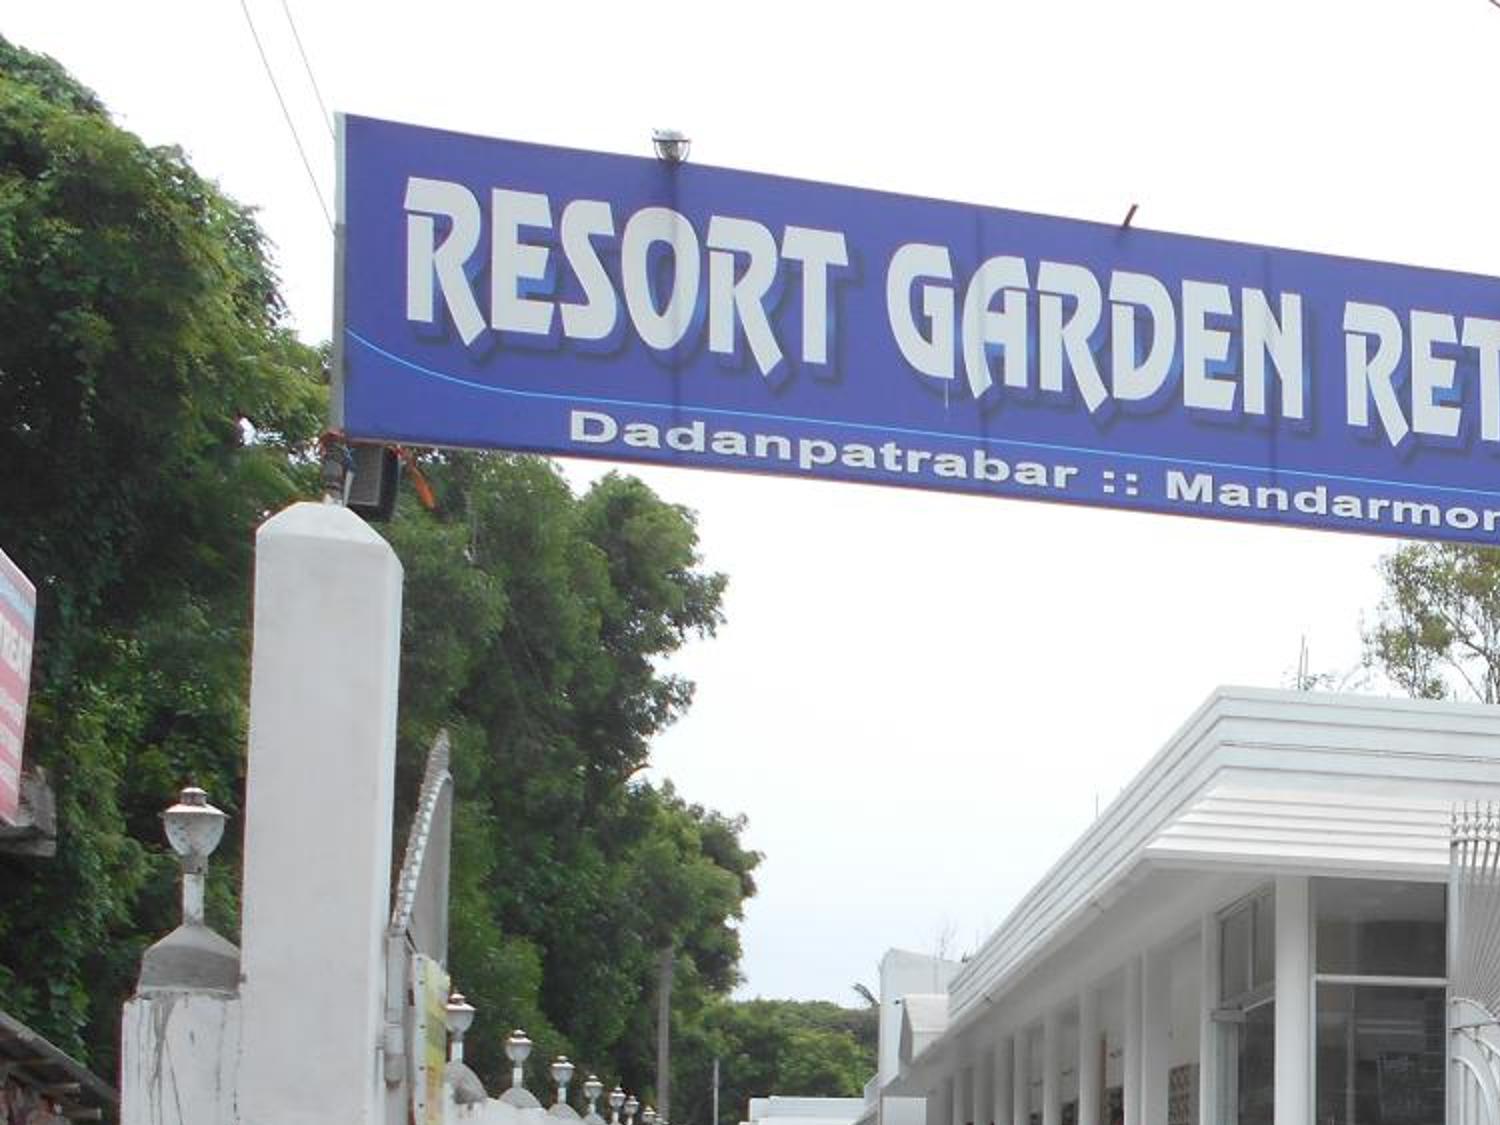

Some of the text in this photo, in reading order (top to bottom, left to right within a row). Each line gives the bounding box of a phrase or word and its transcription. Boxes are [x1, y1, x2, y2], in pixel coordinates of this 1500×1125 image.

[404, 176, 848, 376] RESORT
[886, 243, 1305, 418] GARDEN
[569, 410, 1078, 490] Dadanpatrabar
